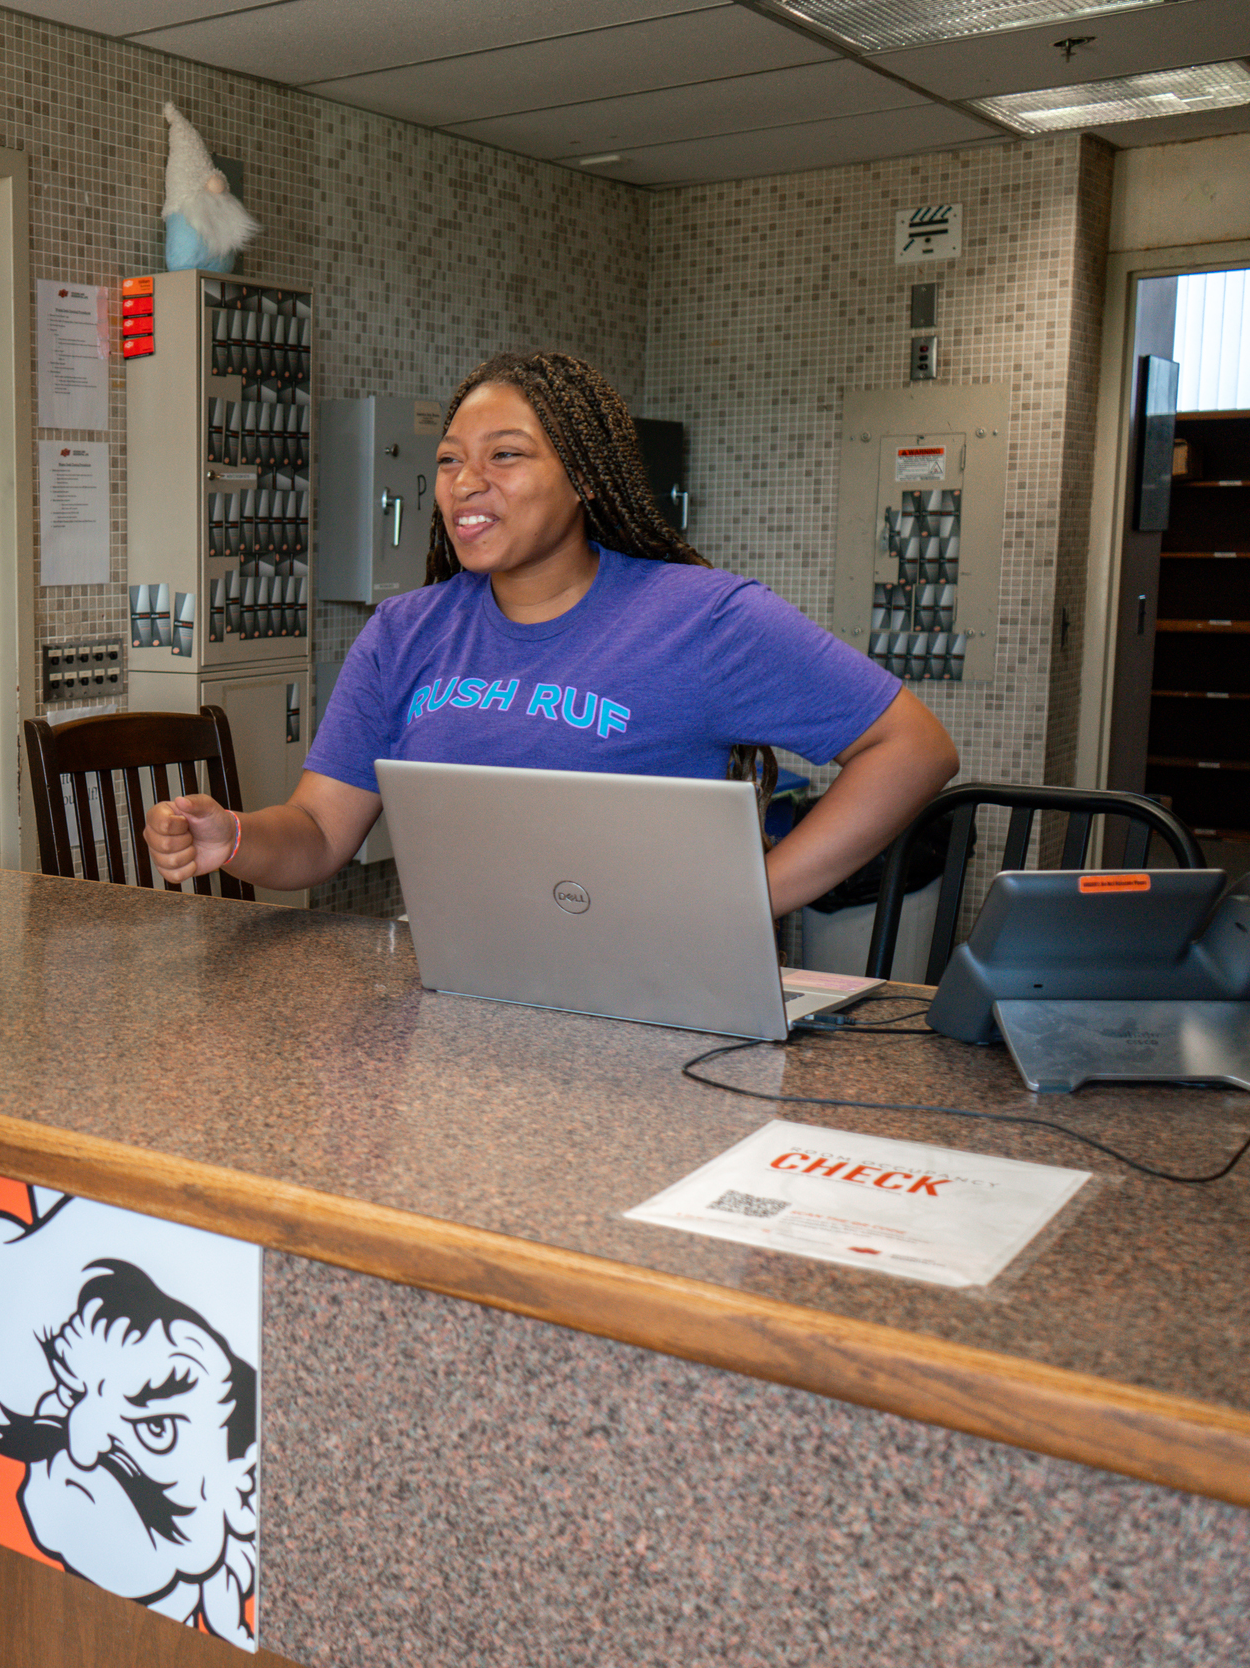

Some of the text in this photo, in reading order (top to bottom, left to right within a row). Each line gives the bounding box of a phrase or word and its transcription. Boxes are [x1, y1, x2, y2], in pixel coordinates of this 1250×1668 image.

[406, 675, 631, 739] RUSH RUF
[558, 892, 587, 903] DELL
[769, 1152, 954, 1197] CHECK
[790, 1147, 851, 1162] ROOM
[861, 1160, 1001, 1188] OCCUPANCY
